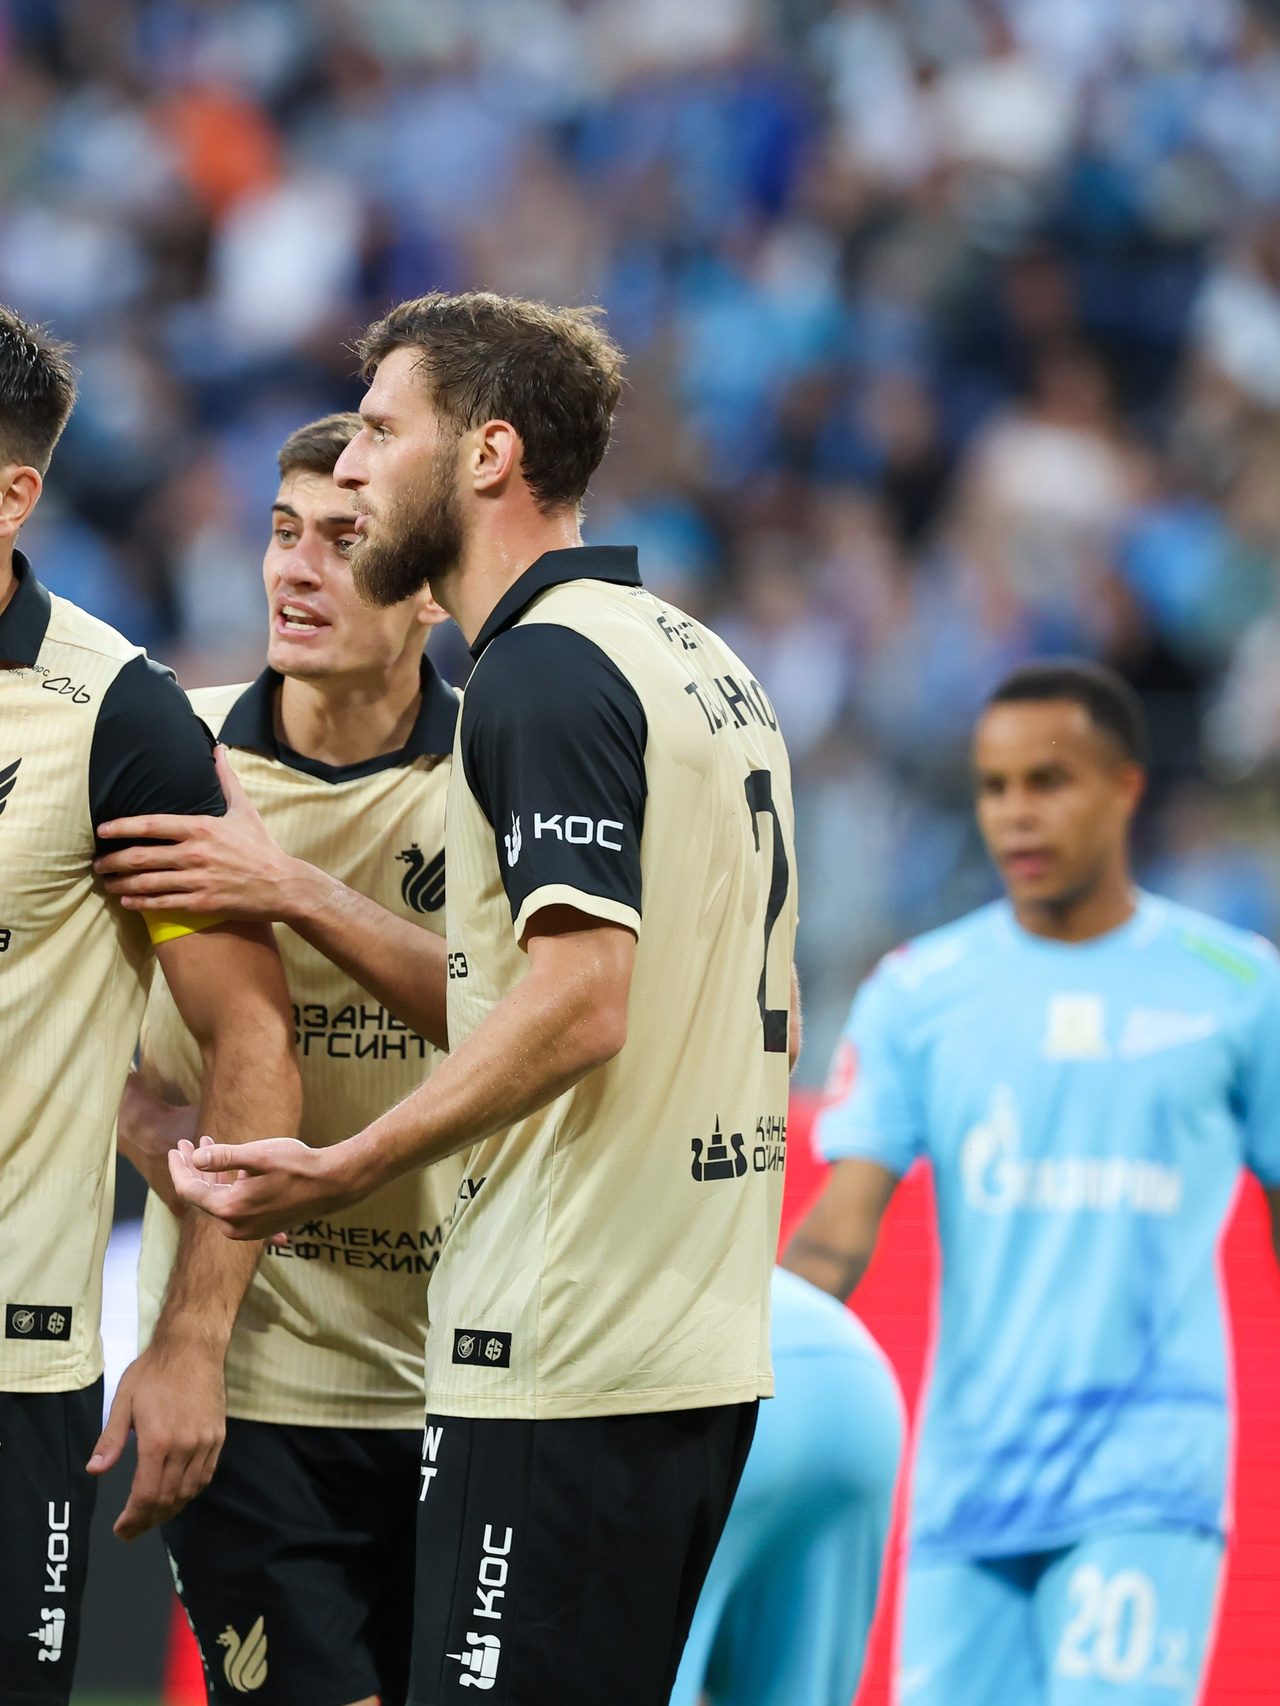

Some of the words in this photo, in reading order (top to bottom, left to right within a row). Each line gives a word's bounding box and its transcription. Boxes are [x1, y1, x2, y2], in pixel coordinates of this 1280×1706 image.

[294, 1031, 426, 1060] ГСИНТ
[288, 1219, 443, 1251] ЖНЕКАМ
[1056, 1563, 1158, 1685] 20
